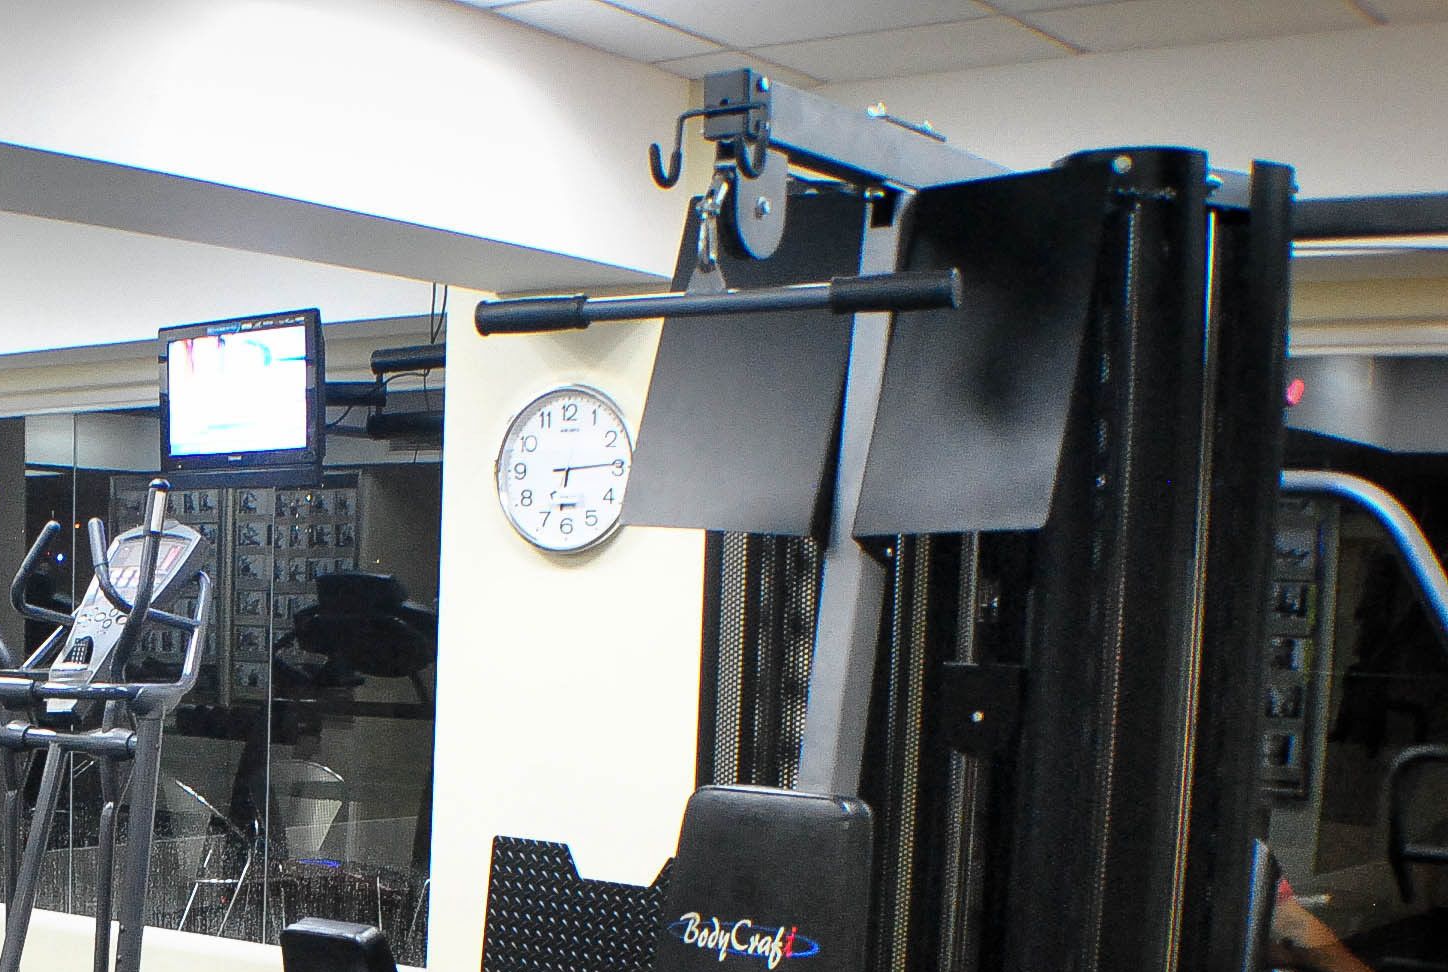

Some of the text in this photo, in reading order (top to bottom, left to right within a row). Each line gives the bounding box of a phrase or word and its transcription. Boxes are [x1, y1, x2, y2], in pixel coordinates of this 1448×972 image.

[540, 411, 551, 429] 11
[561, 404, 578, 421] 12
[591, 409, 597, 426] 1
[521, 436, 537, 453] 10
[605, 430, 617, 448] 2
[514, 463, 527, 480] 9
[612, 459, 625, 477] 3
[520, 490, 532, 507] 8
[603, 488, 614, 504] 4
[539, 512, 551, 528] 7
[560, 518, 573, 534] 6
[585, 510, 598, 527] 5
